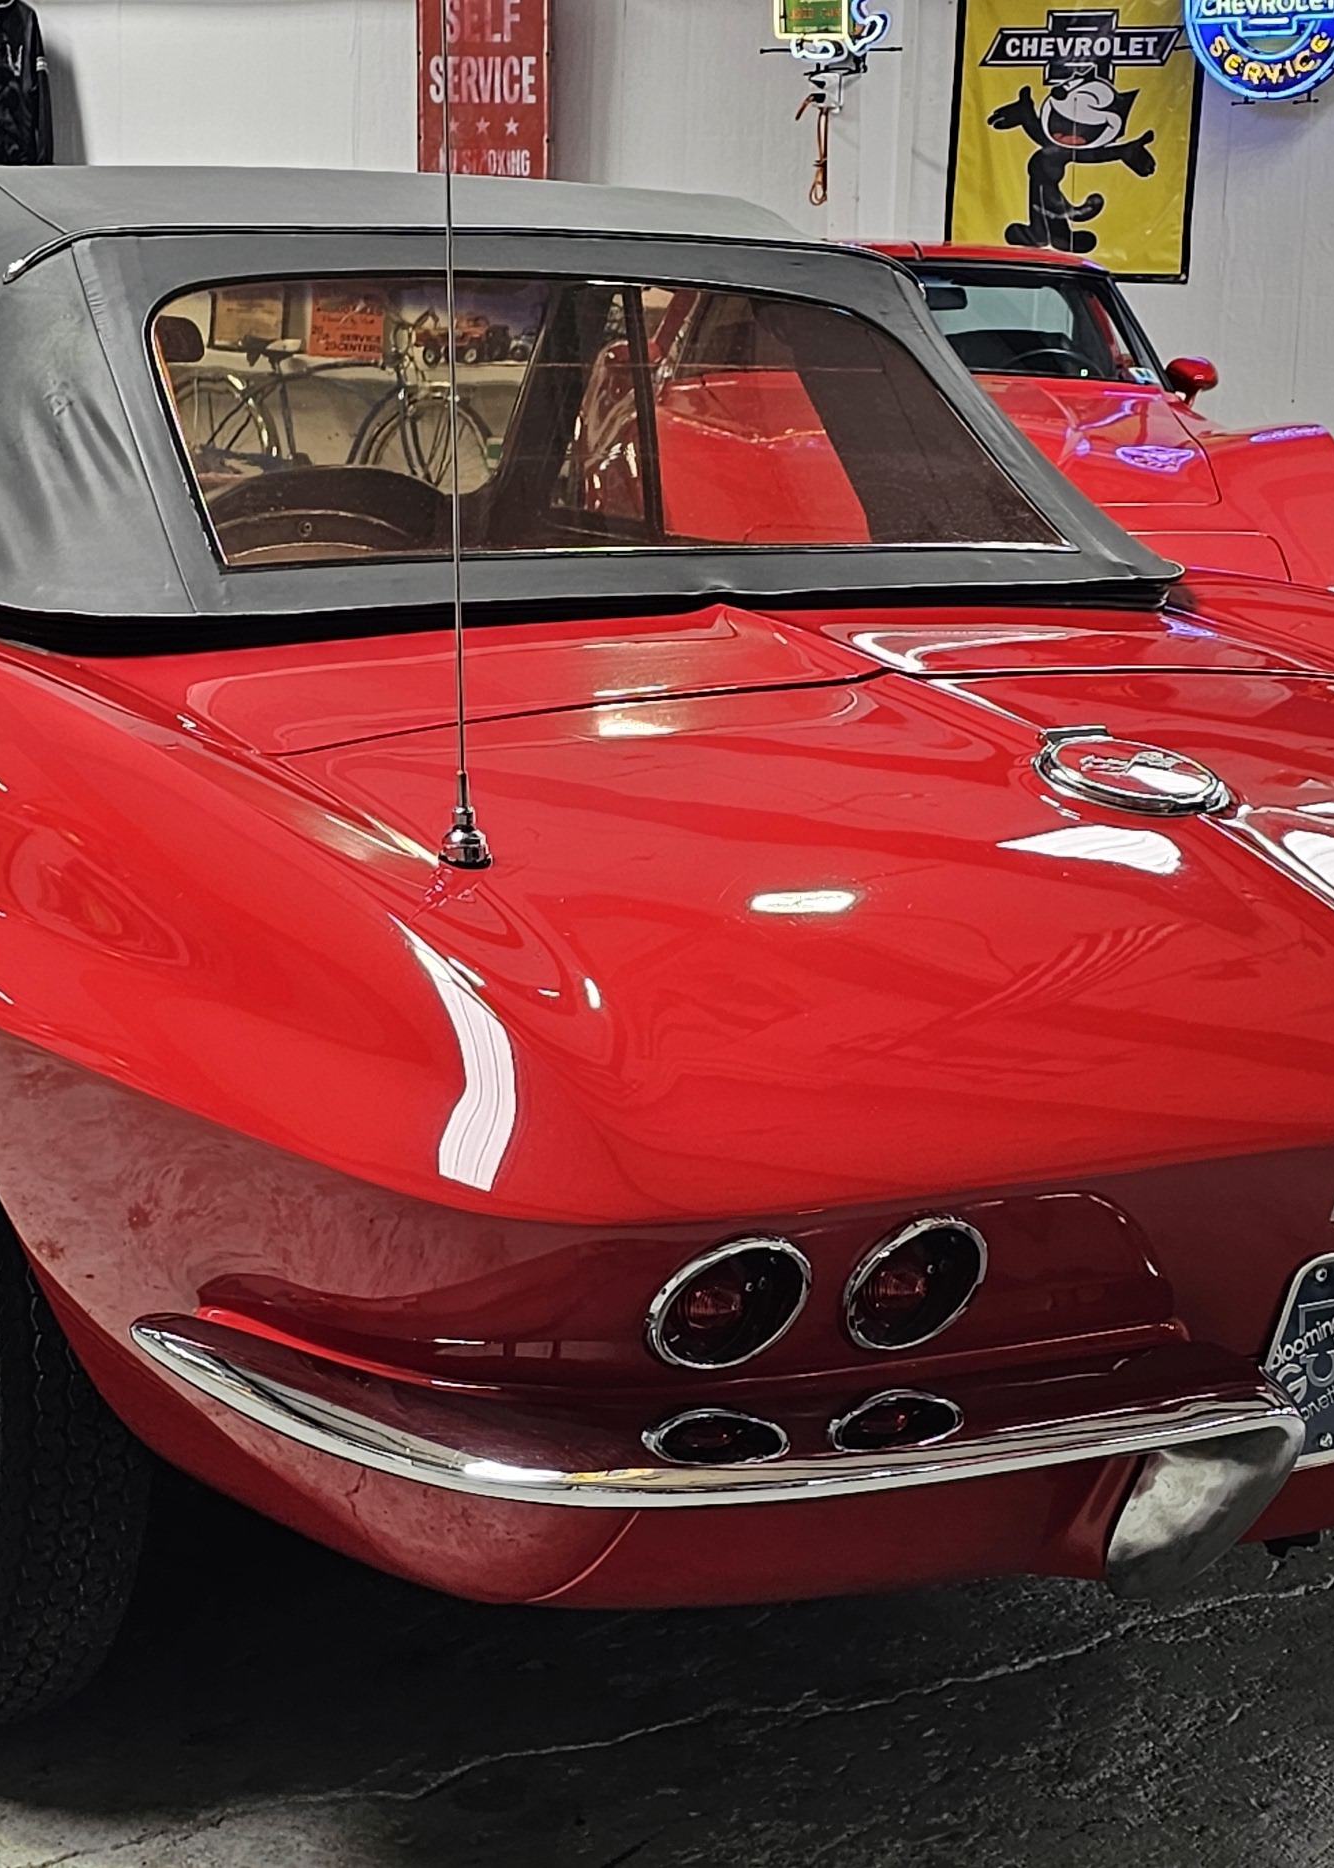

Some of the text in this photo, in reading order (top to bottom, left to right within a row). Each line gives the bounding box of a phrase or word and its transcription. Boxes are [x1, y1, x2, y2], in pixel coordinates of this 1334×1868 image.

[445, 0, 520, 43] SELF
[1004, 37, 1158, 57] CHEVROLET
[1209, 32, 1331, 85] SERVICE
[429, 55, 537, 104] SERVICE
